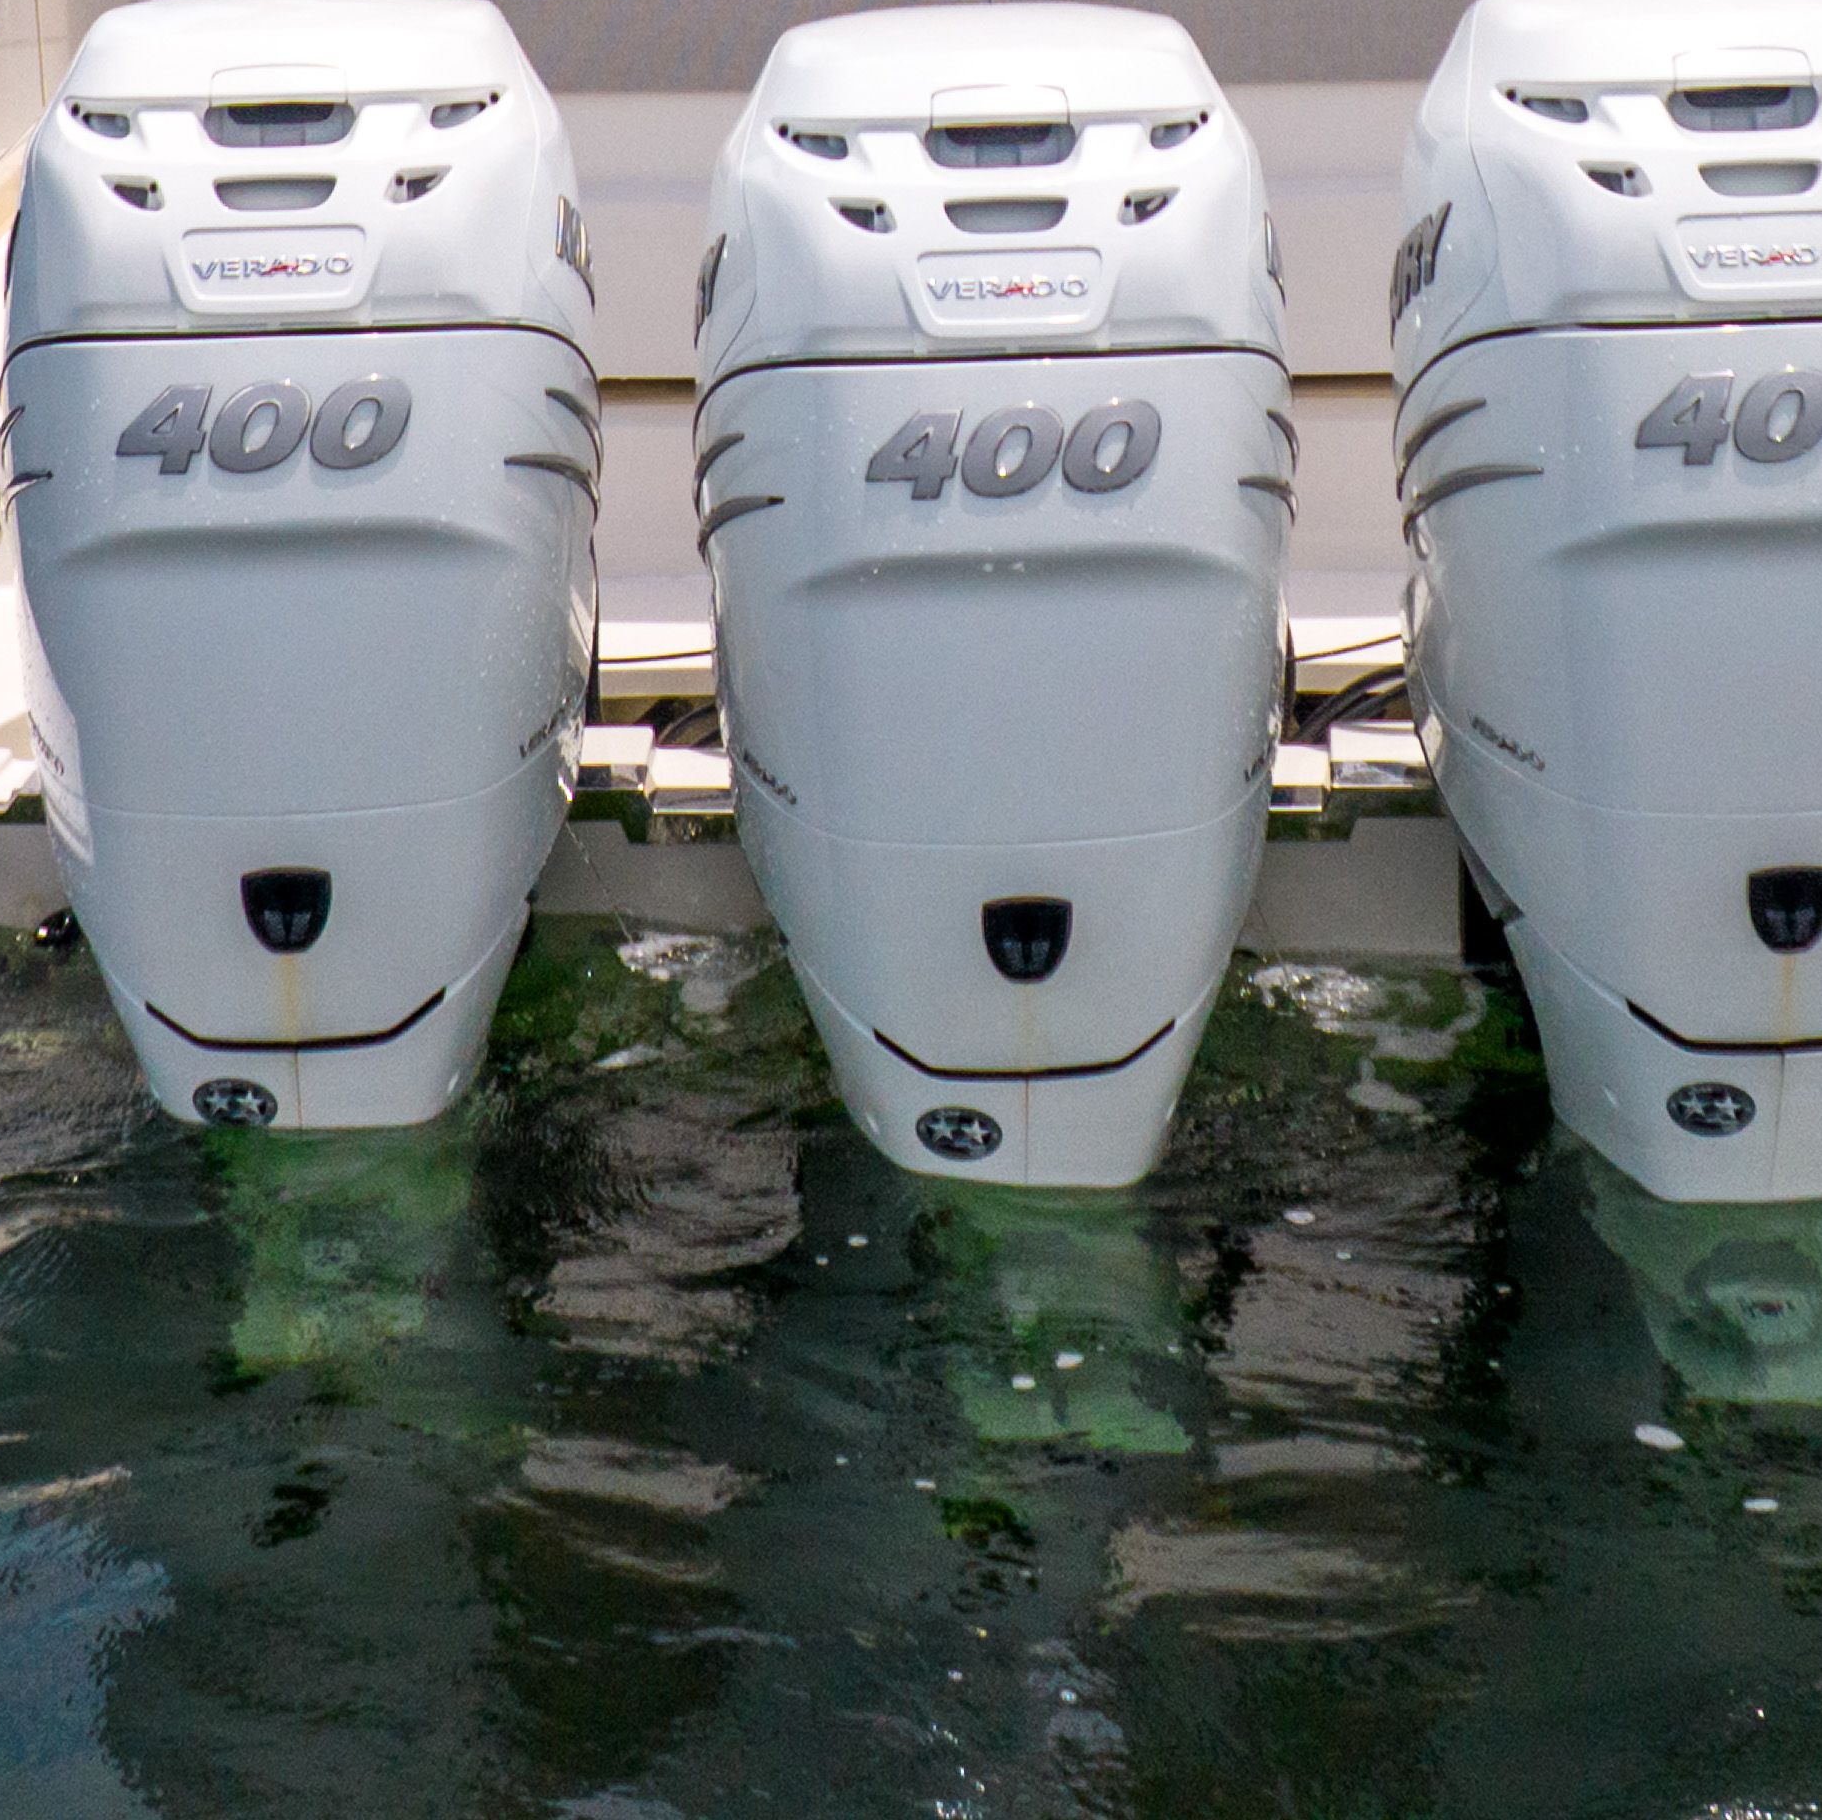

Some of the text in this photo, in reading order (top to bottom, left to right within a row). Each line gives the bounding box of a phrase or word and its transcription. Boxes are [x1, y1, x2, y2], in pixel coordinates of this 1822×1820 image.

[192, 253, 353, 280] VERADO
[927, 274, 1088, 300] VERADO
[116, 376, 412, 475] 400
[865, 398, 1162, 501] 400
